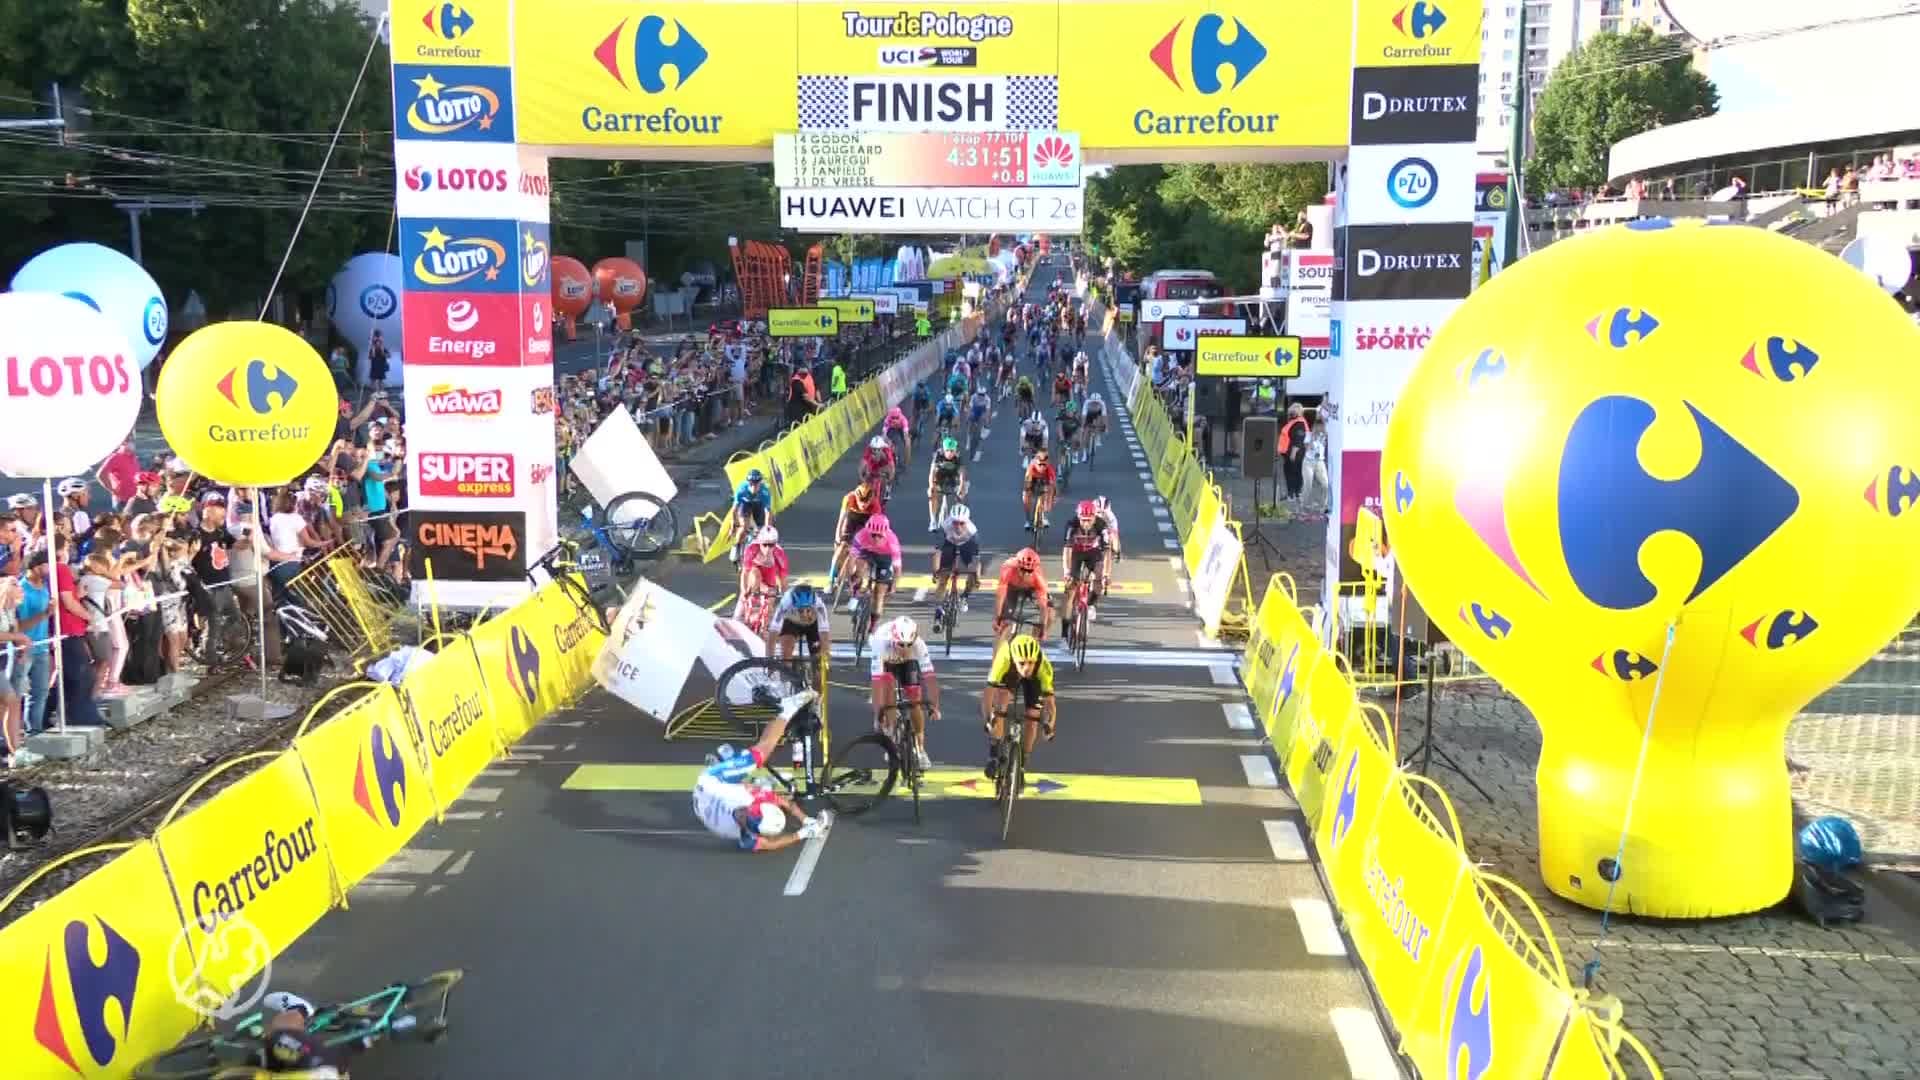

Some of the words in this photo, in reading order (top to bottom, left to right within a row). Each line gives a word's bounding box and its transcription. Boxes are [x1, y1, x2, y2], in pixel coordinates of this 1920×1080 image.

[843, 11, 1013, 41] TourdePologne
[417, 45, 481, 59] Carrefour
[882, 51, 914, 63] UCI
[1383, 45, 1452, 58] Carrefour
[425, 95, 481, 125] LOTTO
[853, 83, 993, 122] FINISH
[1389, 96, 1467, 113] DRUTEX
[582, 107, 723, 134] Carrefour
[1134, 107, 1279, 135] Carrefour
[811, 145, 882, 155] GOUGEARD
[947, 147, 1022, 167] 4:31:51
[437, 169, 507, 191] LOTOS
[793, 177, 807, 187] 21
[794, 167, 807, 176] 17
[1399, 175, 1427, 194] PZU
[786, 196, 905, 218] HUAWEI
[916, 197, 1001, 219] WATCH
[1008, 197, 1038, 219] GT
[1050, 197, 1077, 219] 2e
[431, 248, 489, 275] LOTTO
[1383, 252, 1461, 269] DRUTEX
[429, 336, 495, 358] Energa
[1202, 351, 1260, 362] Carrefour
[7, 354, 129, 397] LOTOS
[428, 389, 500, 413] wawa
[208, 424, 311, 442] Carrefour
[421, 455, 511, 482] SUPER
[457, 482, 512, 494] express
[418, 523, 517, 561] CINEMA
[428, 690, 483, 758] Carrefour
[192, 818, 318, 934] Carrefour
